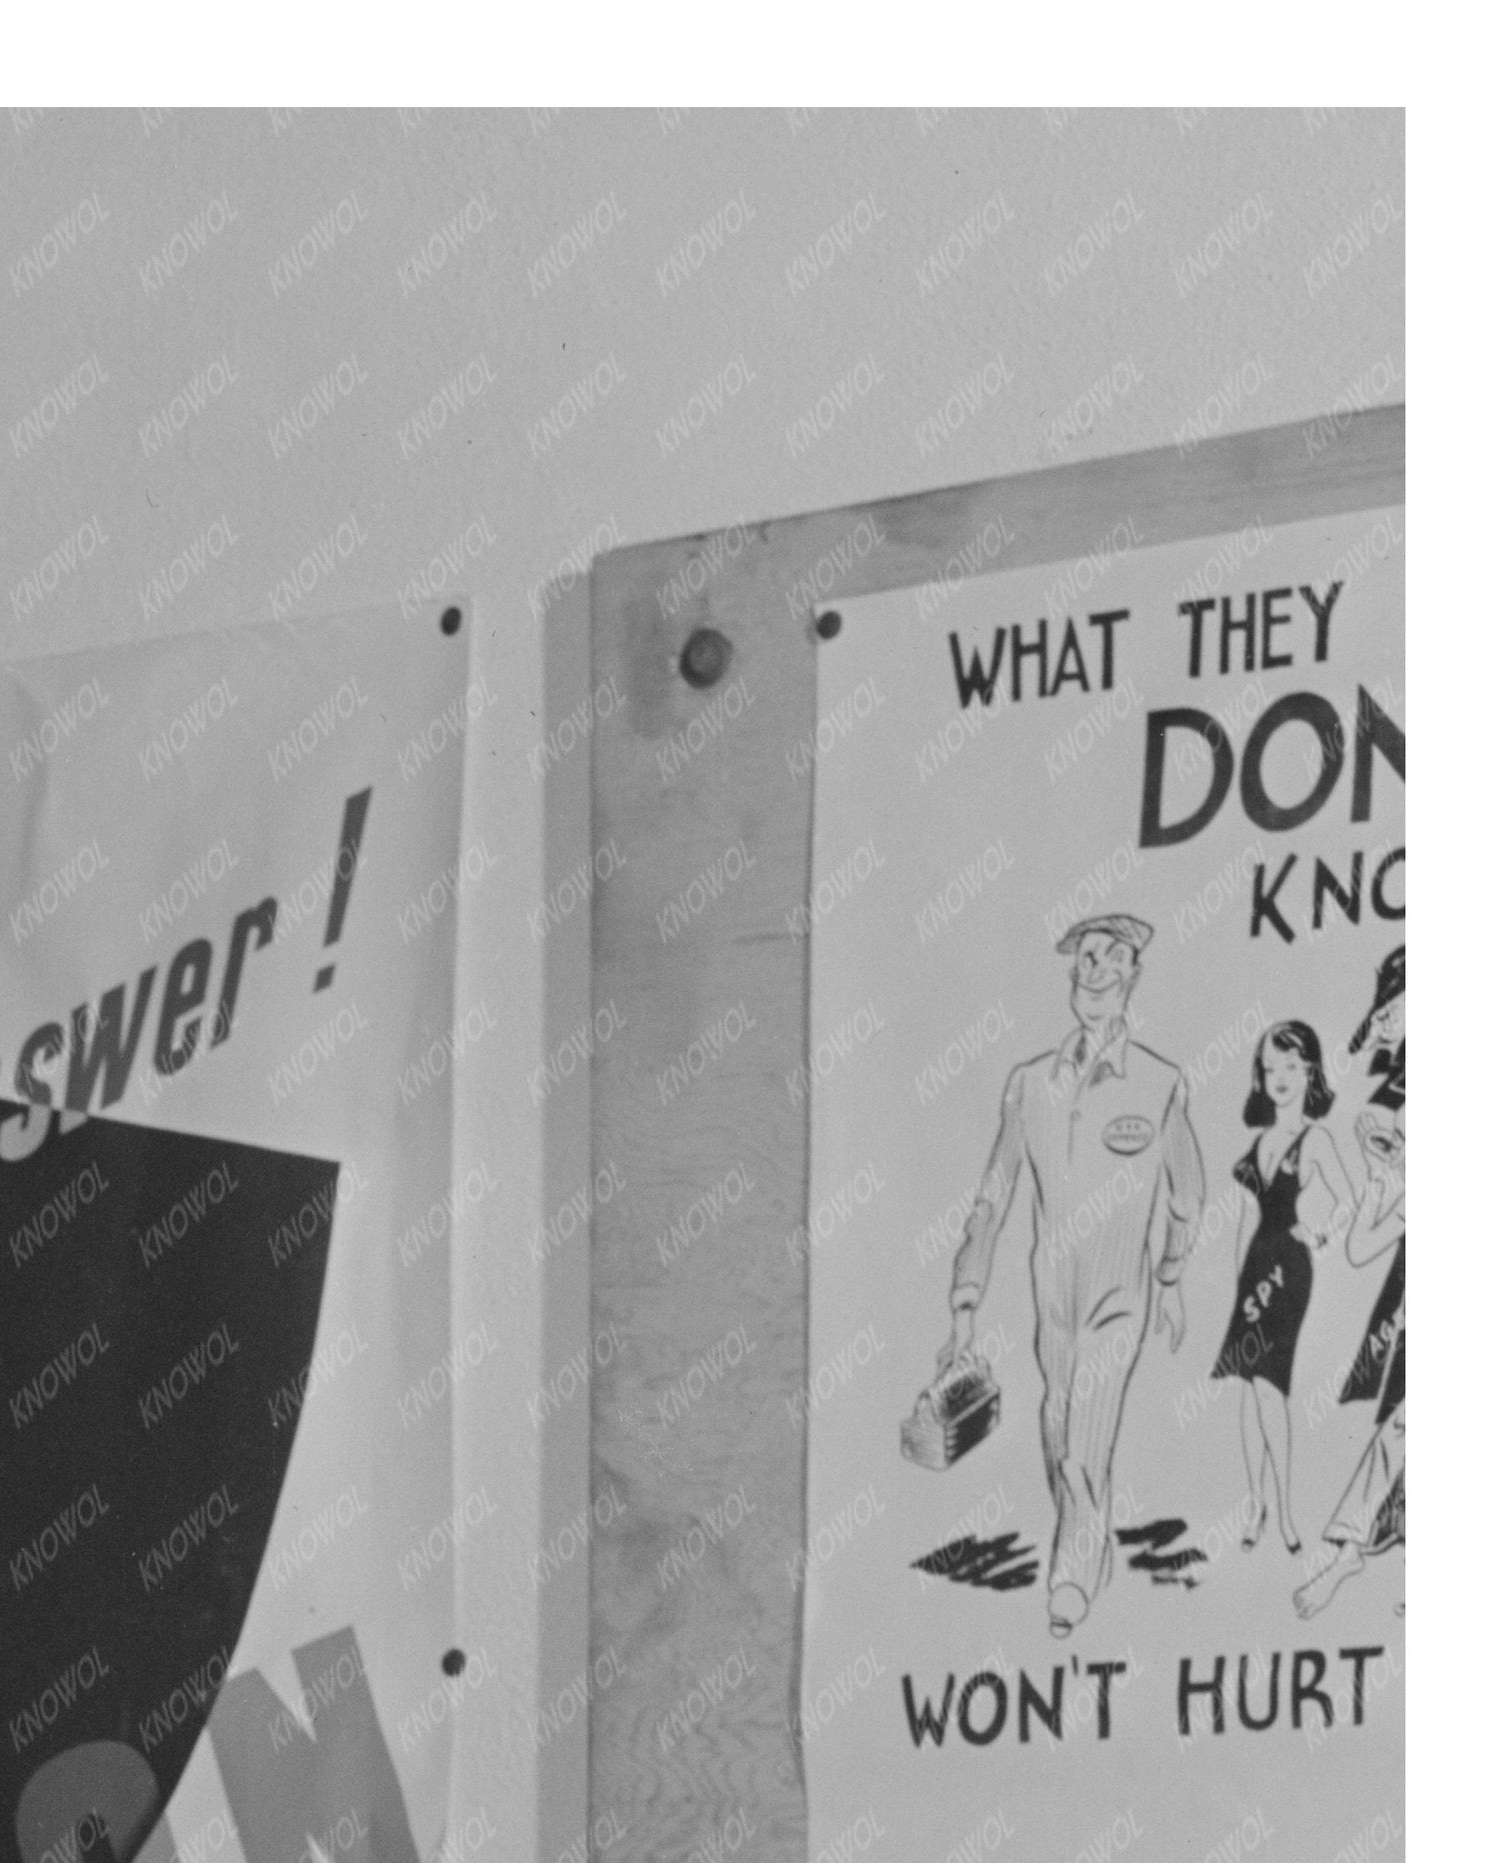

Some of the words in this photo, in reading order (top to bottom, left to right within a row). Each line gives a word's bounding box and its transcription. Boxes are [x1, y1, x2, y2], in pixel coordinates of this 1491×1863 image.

[948, 608, 1131, 710] WHAT
[1177, 580, 1345, 679] THEY
[1242, 1263, 1286, 1323] SPY
[901, 1653, 1128, 1750] WON'T
[1176, 1644, 1386, 1737] HURT
